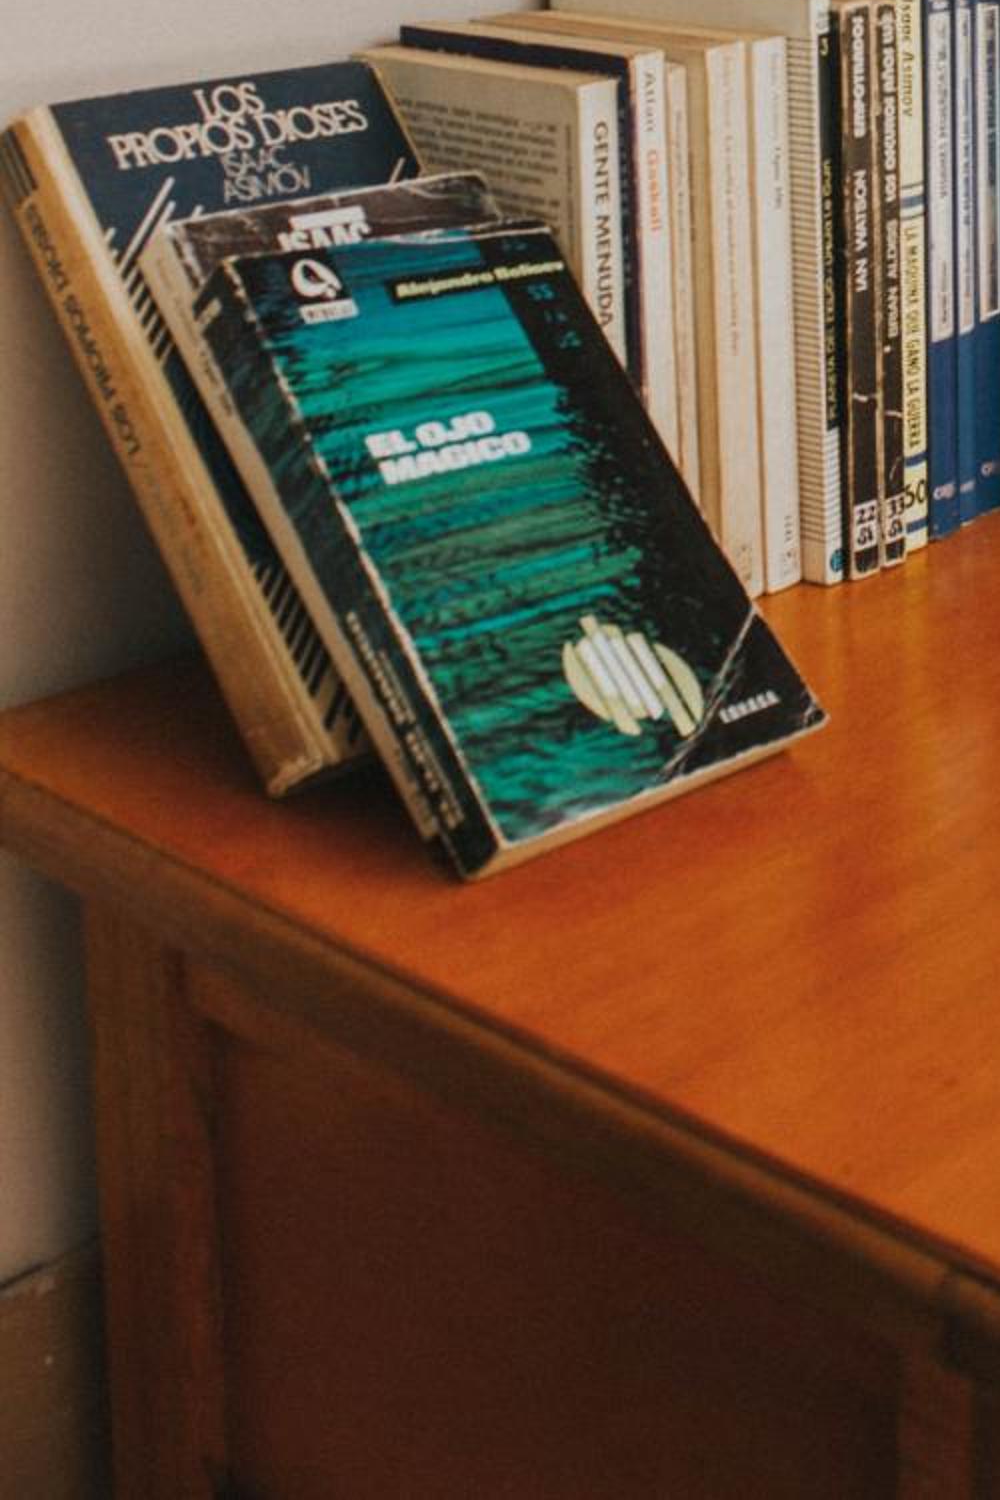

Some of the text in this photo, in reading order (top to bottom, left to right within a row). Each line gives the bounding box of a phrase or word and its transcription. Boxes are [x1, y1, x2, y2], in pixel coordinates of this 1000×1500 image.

[852, 15, 867, 139] EMPOTRADOS
[880, 47, 897, 93] AÑOS
[901, 51, 916, 118] Asimov
[194, 82, 266, 119] LOS
[106, 98, 369, 170] PROPIOS DIOSES
[882, 96, 897, 171] OSCUROS
[221, 146, 293, 179] ISAAC
[222, 173, 312, 204] ASIMOV
[883, 173, 897, 205] LOS
[592, 122, 614, 328] GENTE MENUDA
[852, 168, 868, 293] IAN WATSON
[395, 271, 494, 300] Alejandro
[885, 217, 900, 338] BRIAN ALDISS
[825, 325, 836, 350] DEL
[903, 227, 922, 450] LA MAQUINA QUE GANO LA GUERRA
[825, 354, 837, 419] PLANETA
[364, 411, 496, 459] EL OJO
[379, 430, 532, 486] MAGICO
[857, 505, 876, 525] 22
